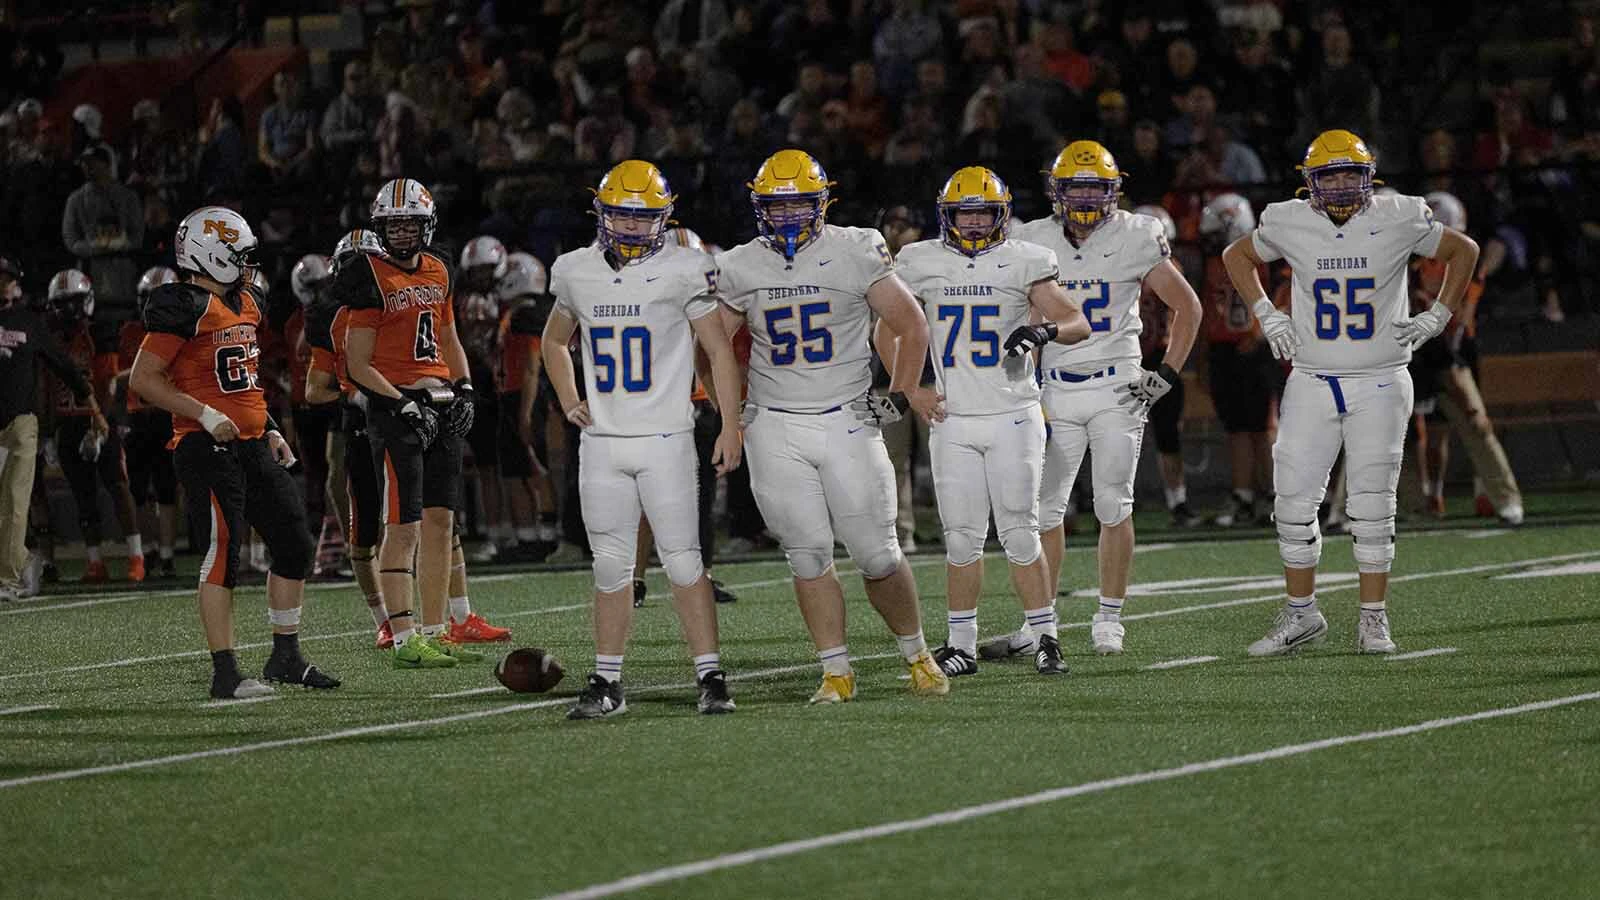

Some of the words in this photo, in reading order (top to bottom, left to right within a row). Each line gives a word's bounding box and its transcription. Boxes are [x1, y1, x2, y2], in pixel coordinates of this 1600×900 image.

[1316, 256, 1368, 270] SHERIDAN
[593, 304, 641, 318] SHERIDAN
[768, 284, 820, 300] SHERIDAN
[943, 285, 993, 297] SHERIDAN
[1311, 276, 1376, 341] 65
[413, 310, 438, 364] 4
[588, 325, 653, 393] 50
[763, 301, 833, 367] 55
[936, 303, 1001, 368] 75
